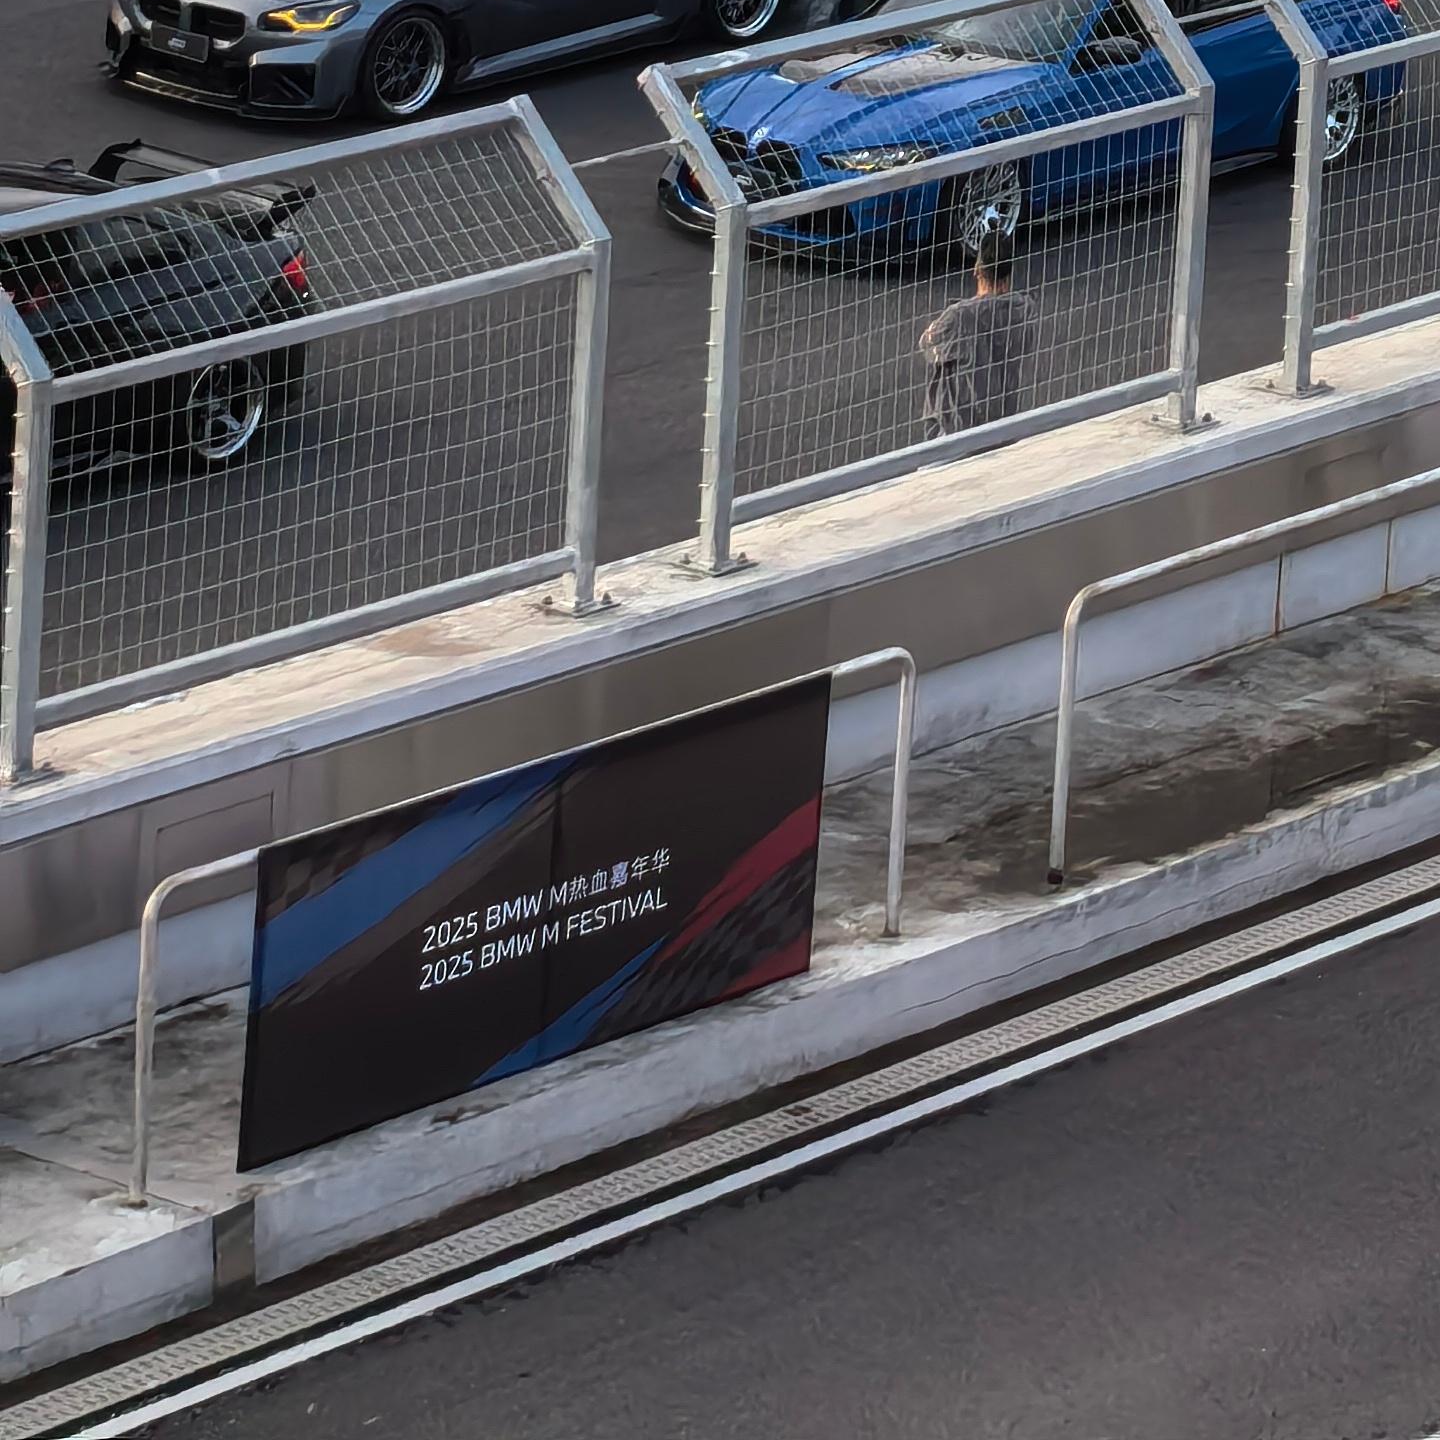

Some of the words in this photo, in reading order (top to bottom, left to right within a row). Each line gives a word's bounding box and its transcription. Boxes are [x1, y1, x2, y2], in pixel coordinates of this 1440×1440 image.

[419, 949, 474, 991] 2025
[480, 928, 537, 969] BMW
[541, 921, 560, 950] M
[566, 886, 669, 940] FESTIVAL
[421, 911, 479, 954] 2025
[485, 888, 544, 932] BMW
